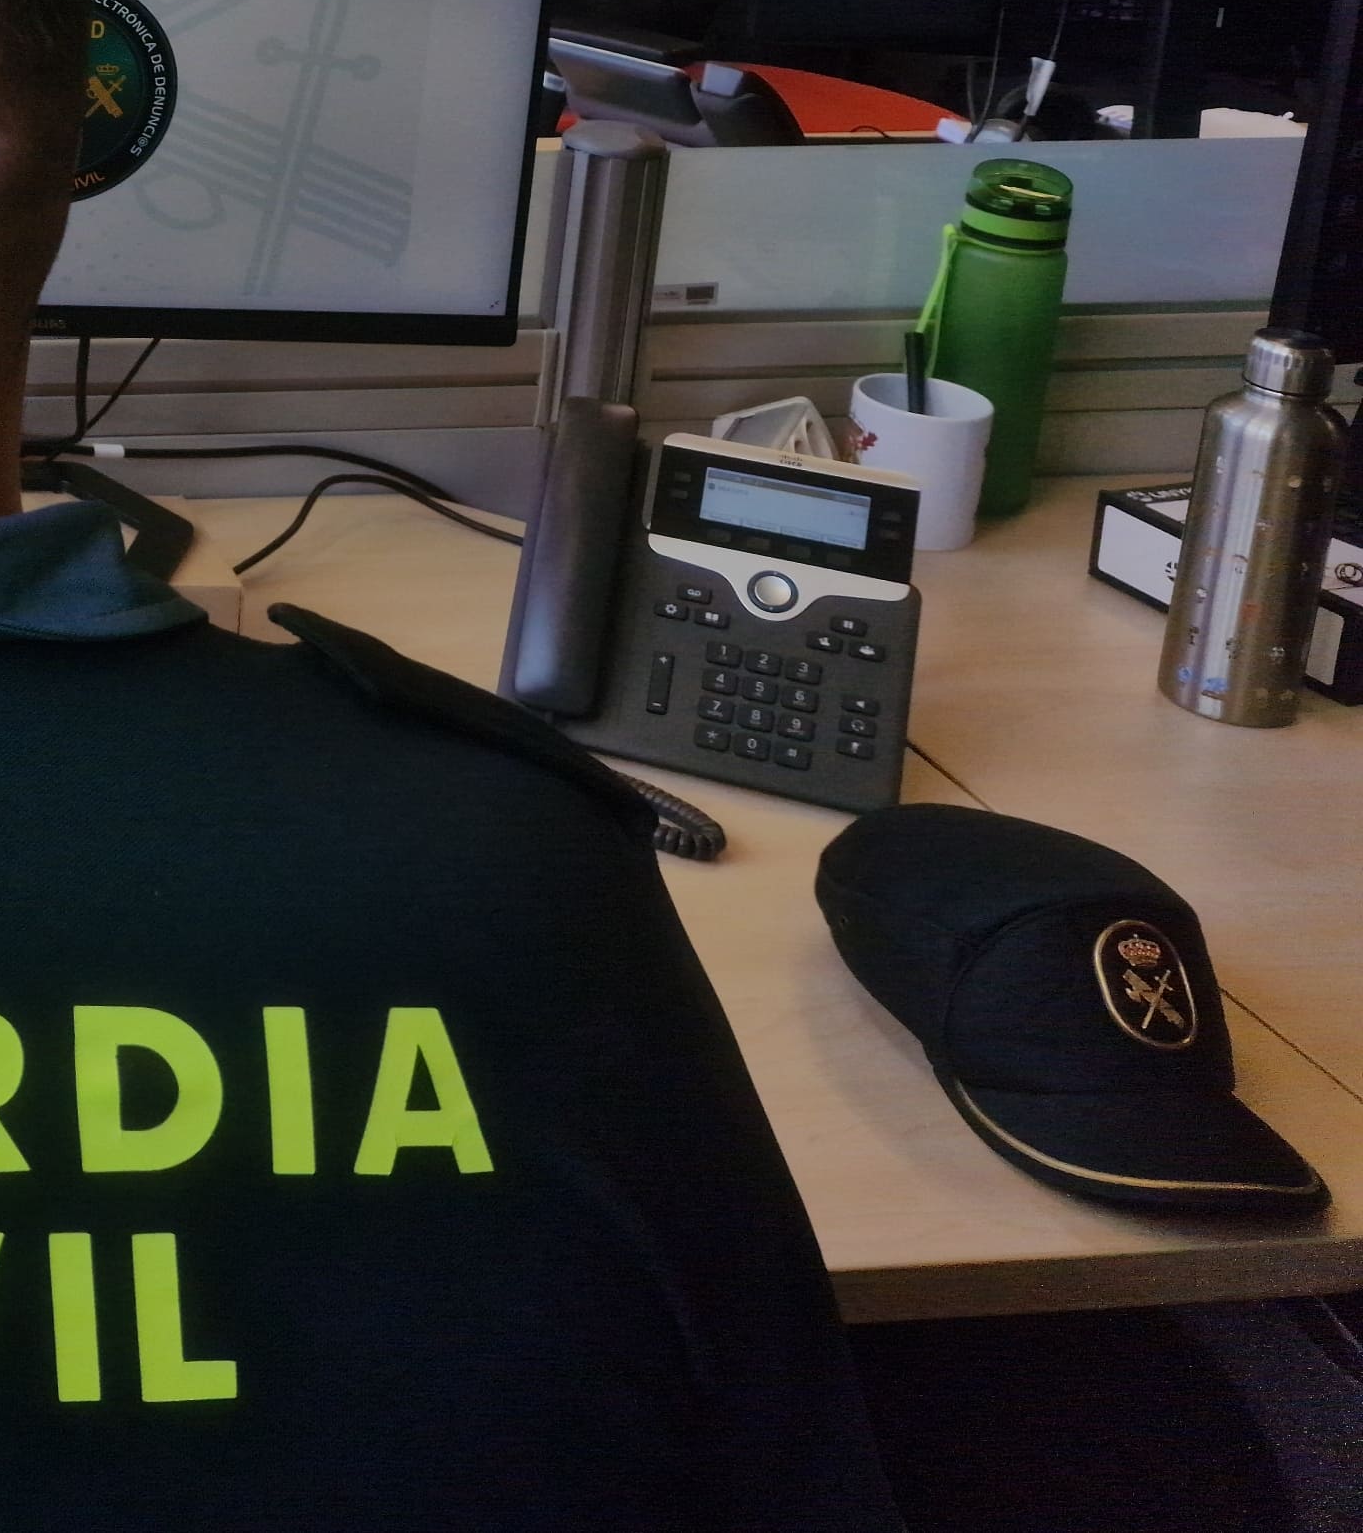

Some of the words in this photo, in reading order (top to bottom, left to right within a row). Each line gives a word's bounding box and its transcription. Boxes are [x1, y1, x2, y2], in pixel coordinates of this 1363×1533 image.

[150, 53, 165, 73] DE
[73, 170, 106, 190] IVIL
[759, 653, 769, 665] 2
[797, 661, 809, 673] 3
[715, 673, 725, 684] 4
[755, 681, 765, 693] 5
[795, 690, 805, 701] 6
[712, 699, 722, 711] 7
[751, 709, 761, 721] 8
[791, 717, 802, 729] 9
[746, 738, 758, 750] 0
